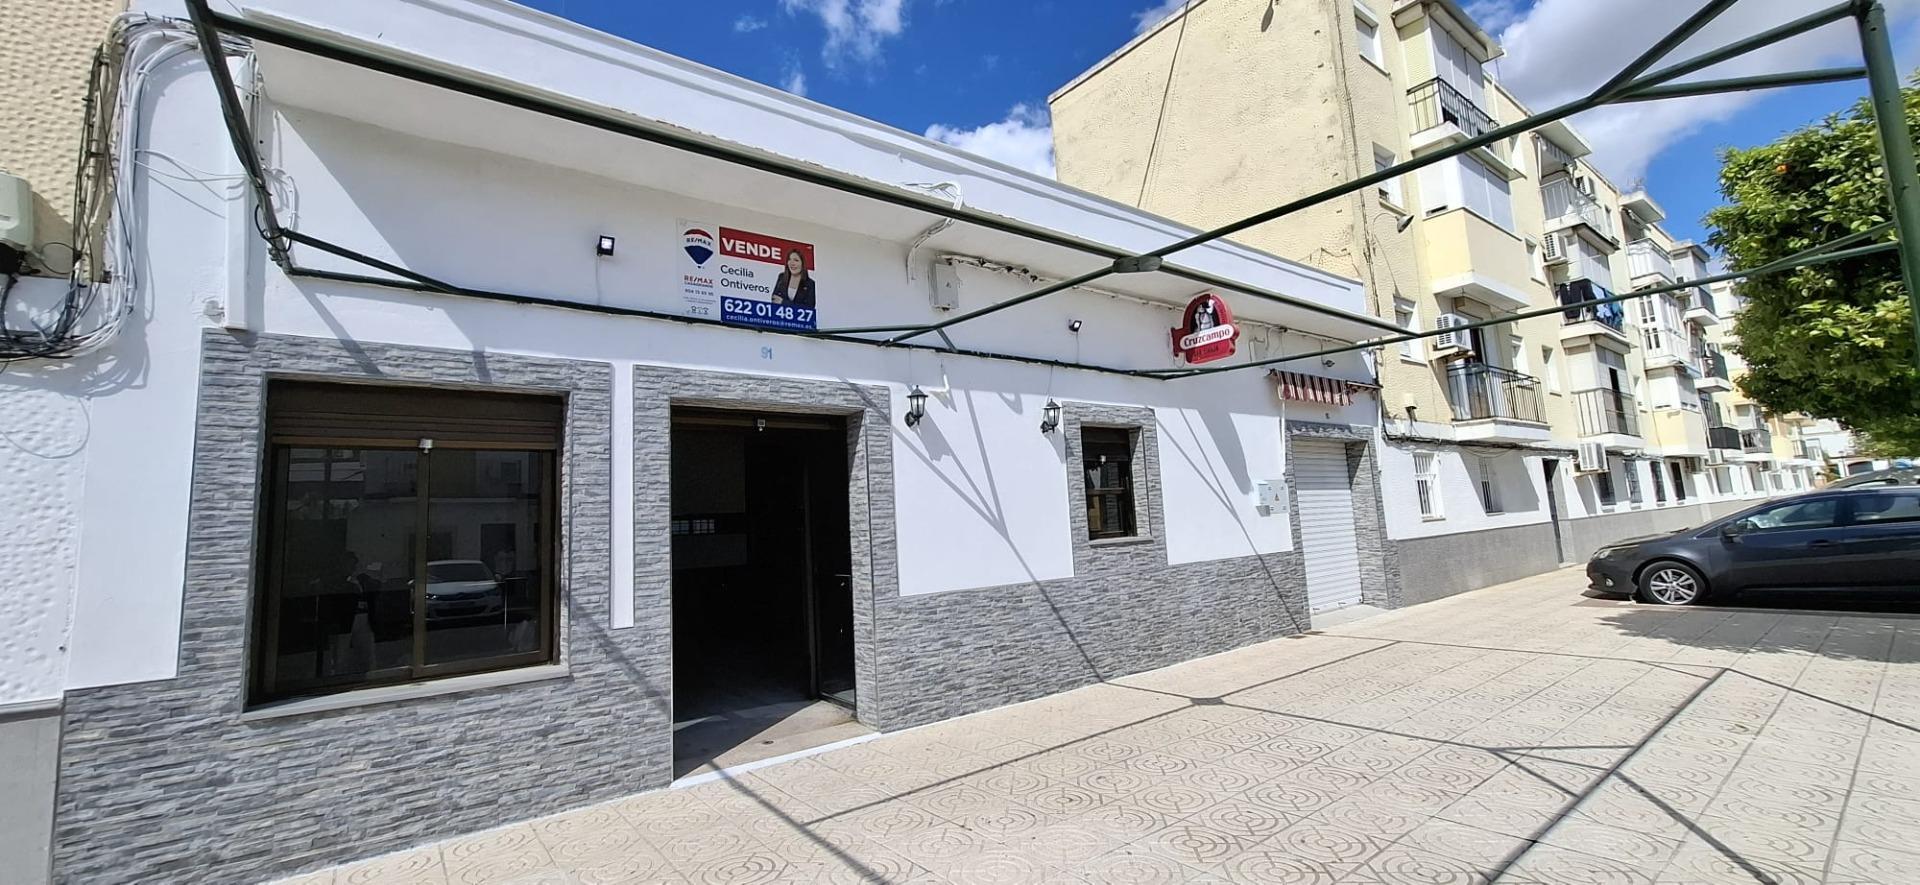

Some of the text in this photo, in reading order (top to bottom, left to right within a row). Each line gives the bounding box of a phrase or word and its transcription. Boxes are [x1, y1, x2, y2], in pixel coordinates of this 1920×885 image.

[686, 237, 712, 246] RE/MAX
[721, 237, 782, 260] VENDE
[720, 264, 754, 278] Cecilia
[684, 275, 713, 285] RE/MAX
[720, 278, 770, 294] Ontiveros
[724, 299, 752, 315] 622
[756, 303, 772, 318] 01
[776, 307, 794, 320] 48
[797, 310, 814, 322] 27
[1184, 328, 1230, 347] Cruzcampo
[761, 346, 772, 360] 91
